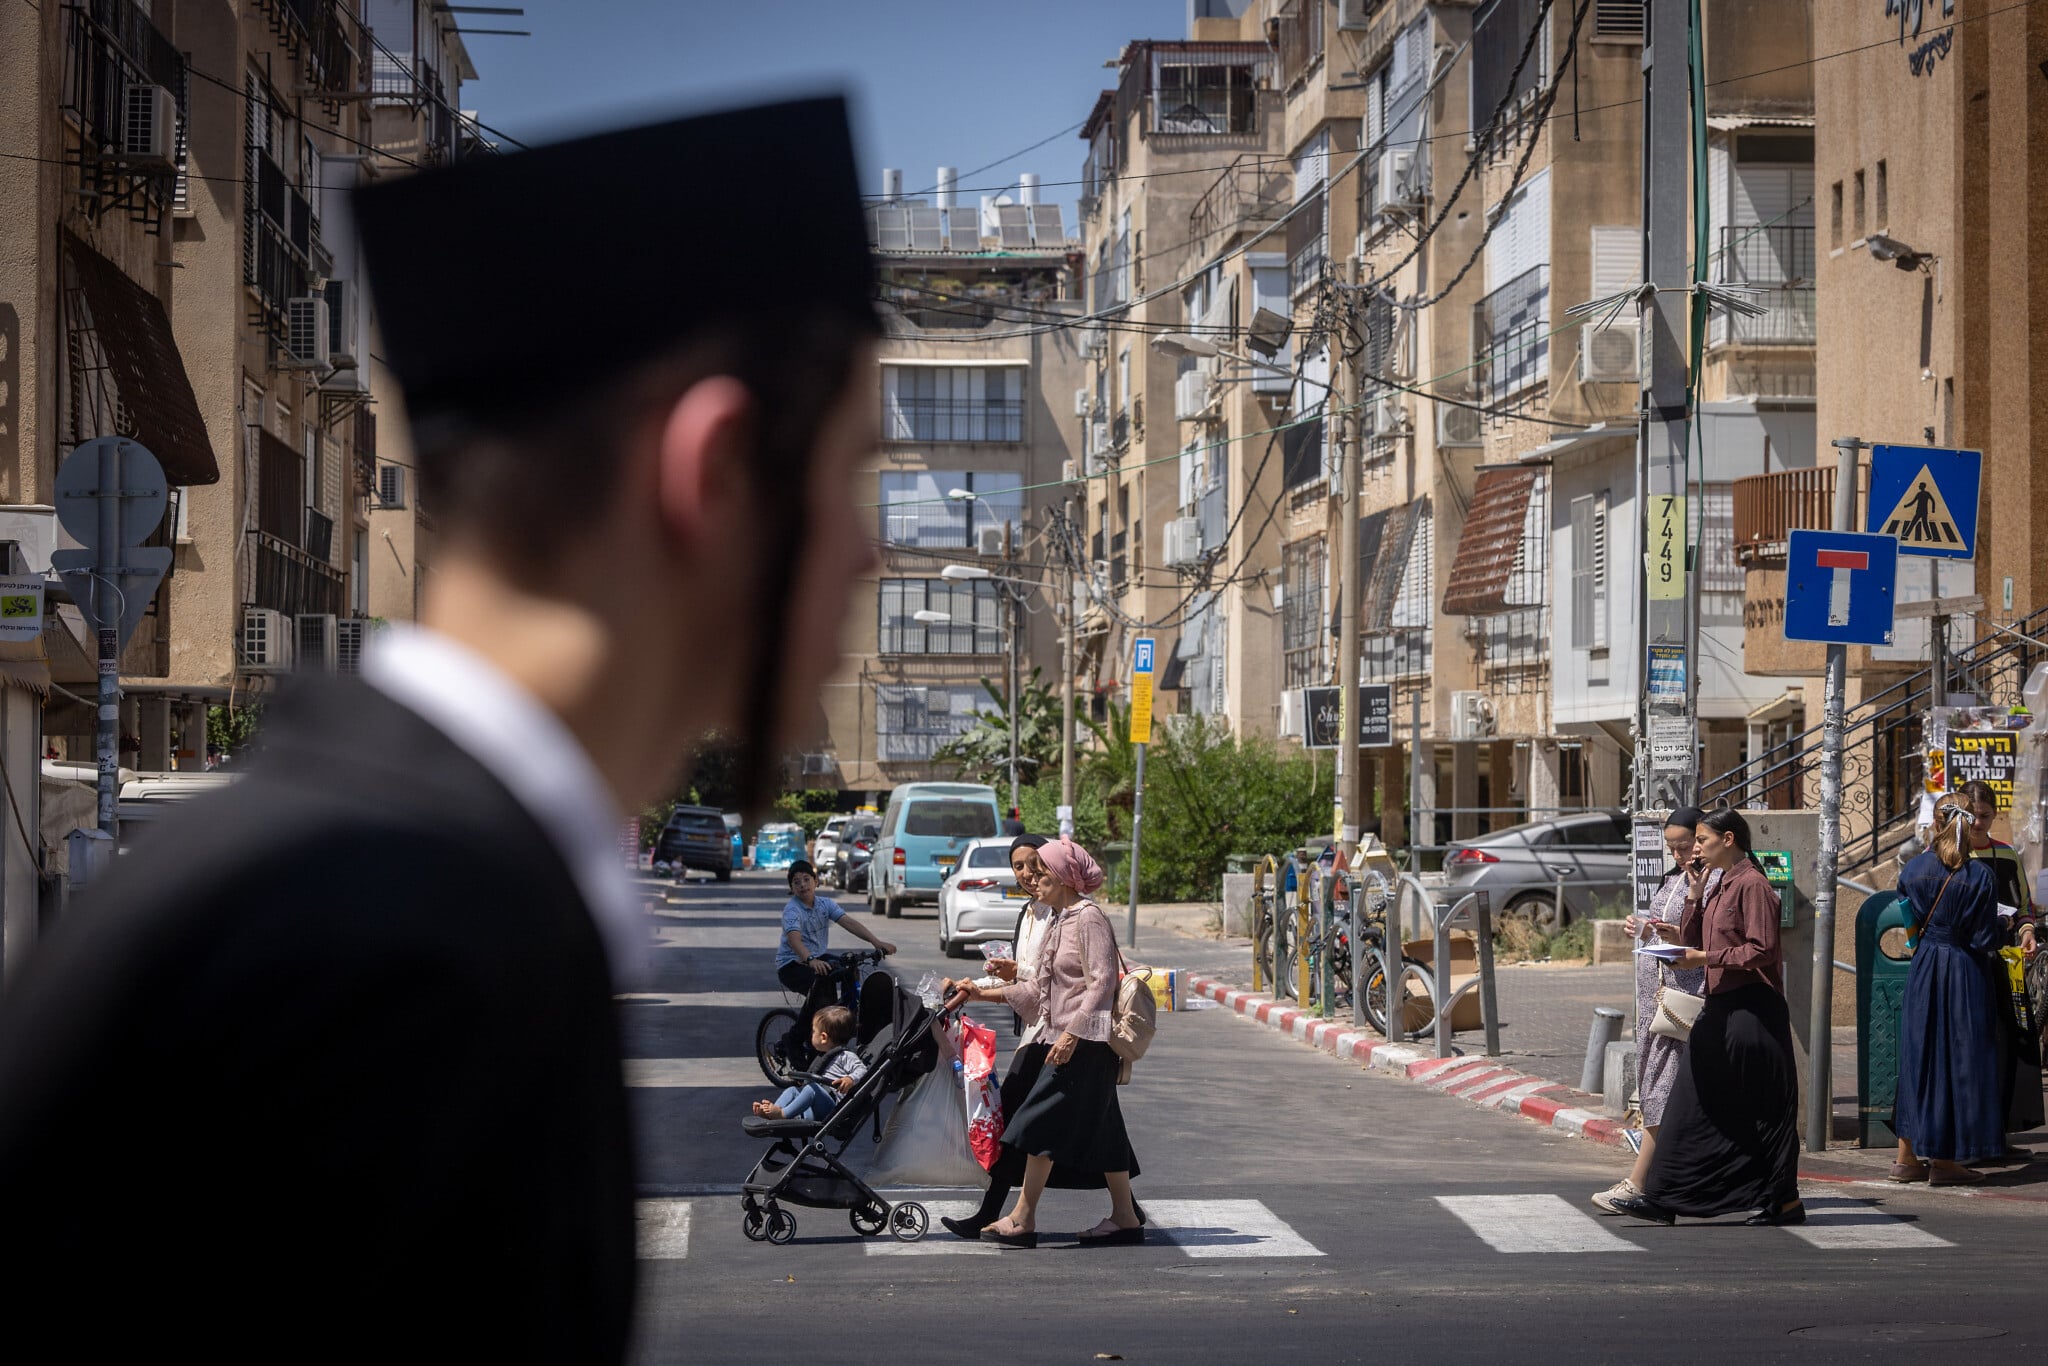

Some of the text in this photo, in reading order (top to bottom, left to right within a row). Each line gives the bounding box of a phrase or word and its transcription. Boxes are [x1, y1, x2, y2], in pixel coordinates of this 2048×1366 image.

[1660, 498, 1674, 583] 7449
[1954, 737, 2011, 752] היום!
[1951, 753, 1989, 767] אתה
[1992, 754, 2015, 767] גם
[1960, 767, 2006, 782] שותף
